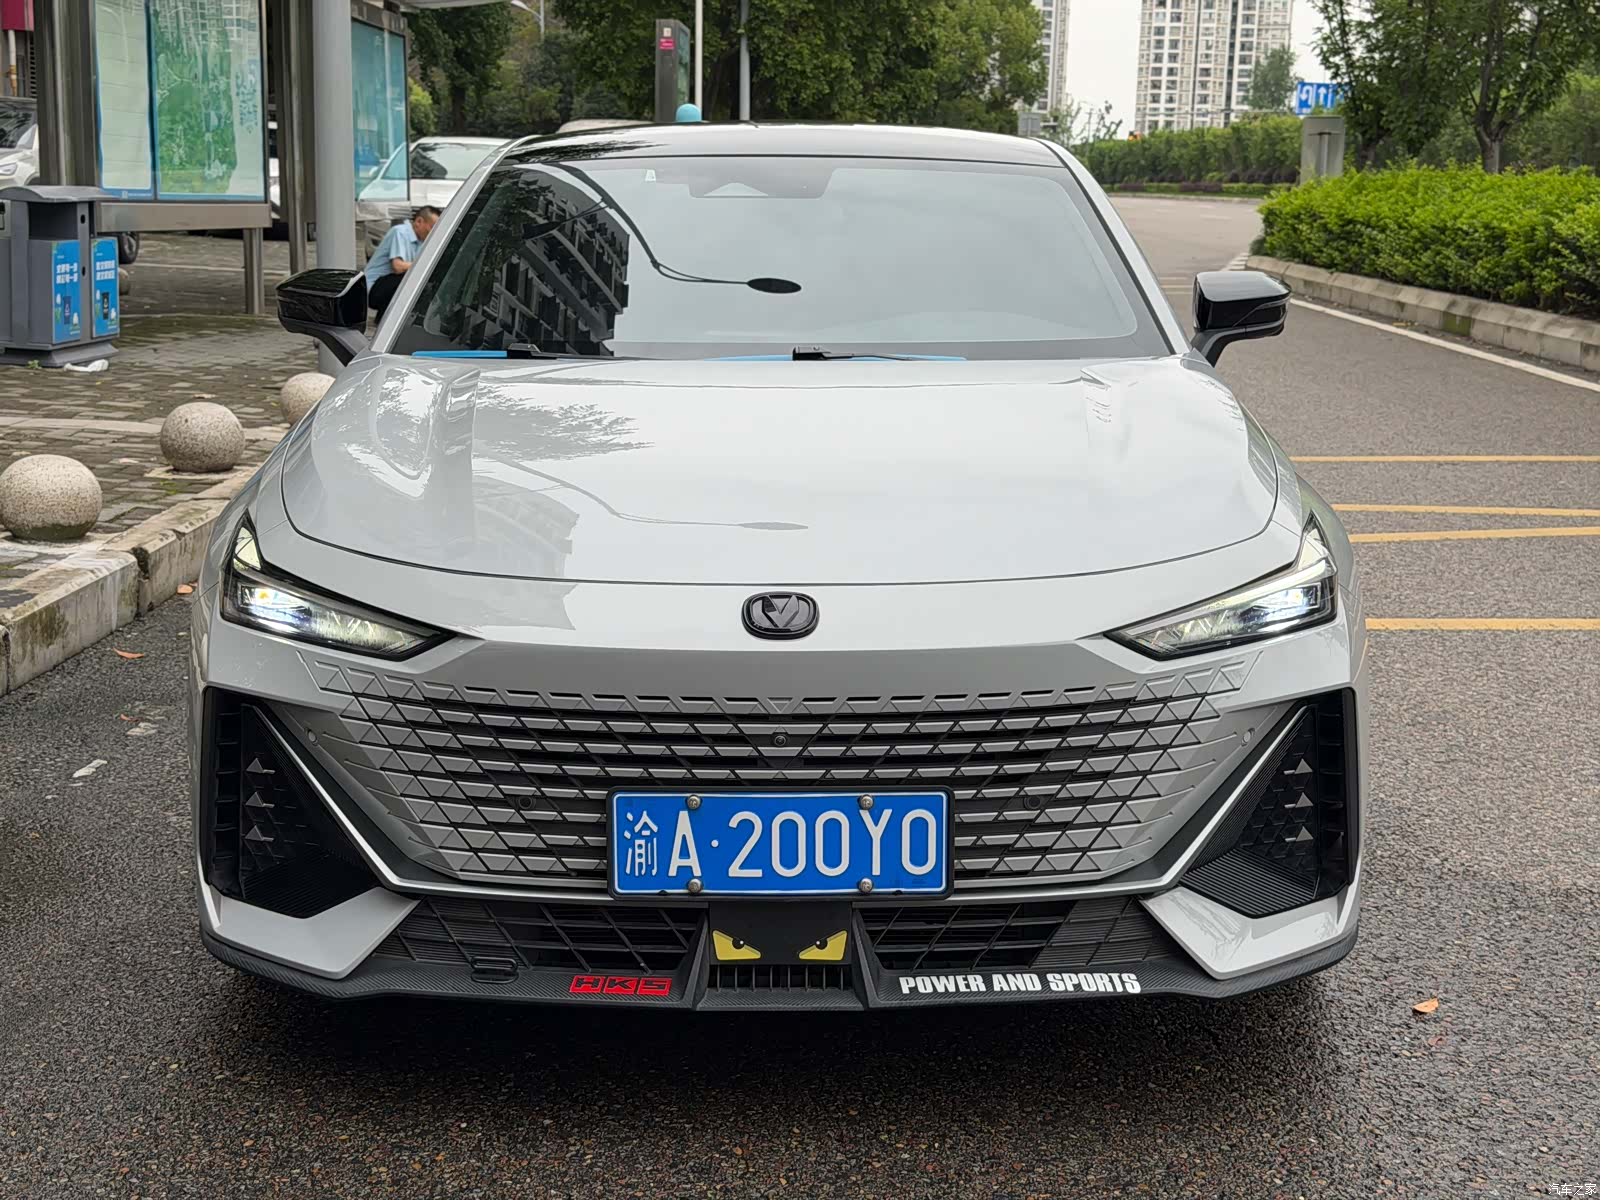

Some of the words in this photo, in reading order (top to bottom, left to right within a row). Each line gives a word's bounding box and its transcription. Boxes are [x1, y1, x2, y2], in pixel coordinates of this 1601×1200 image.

[569, 974, 673, 996] HKS
[898, 974, 987, 994] POWER
[991, 973, 1043, 993] AND
[1046, 972, 1142, 994] SPORTS
